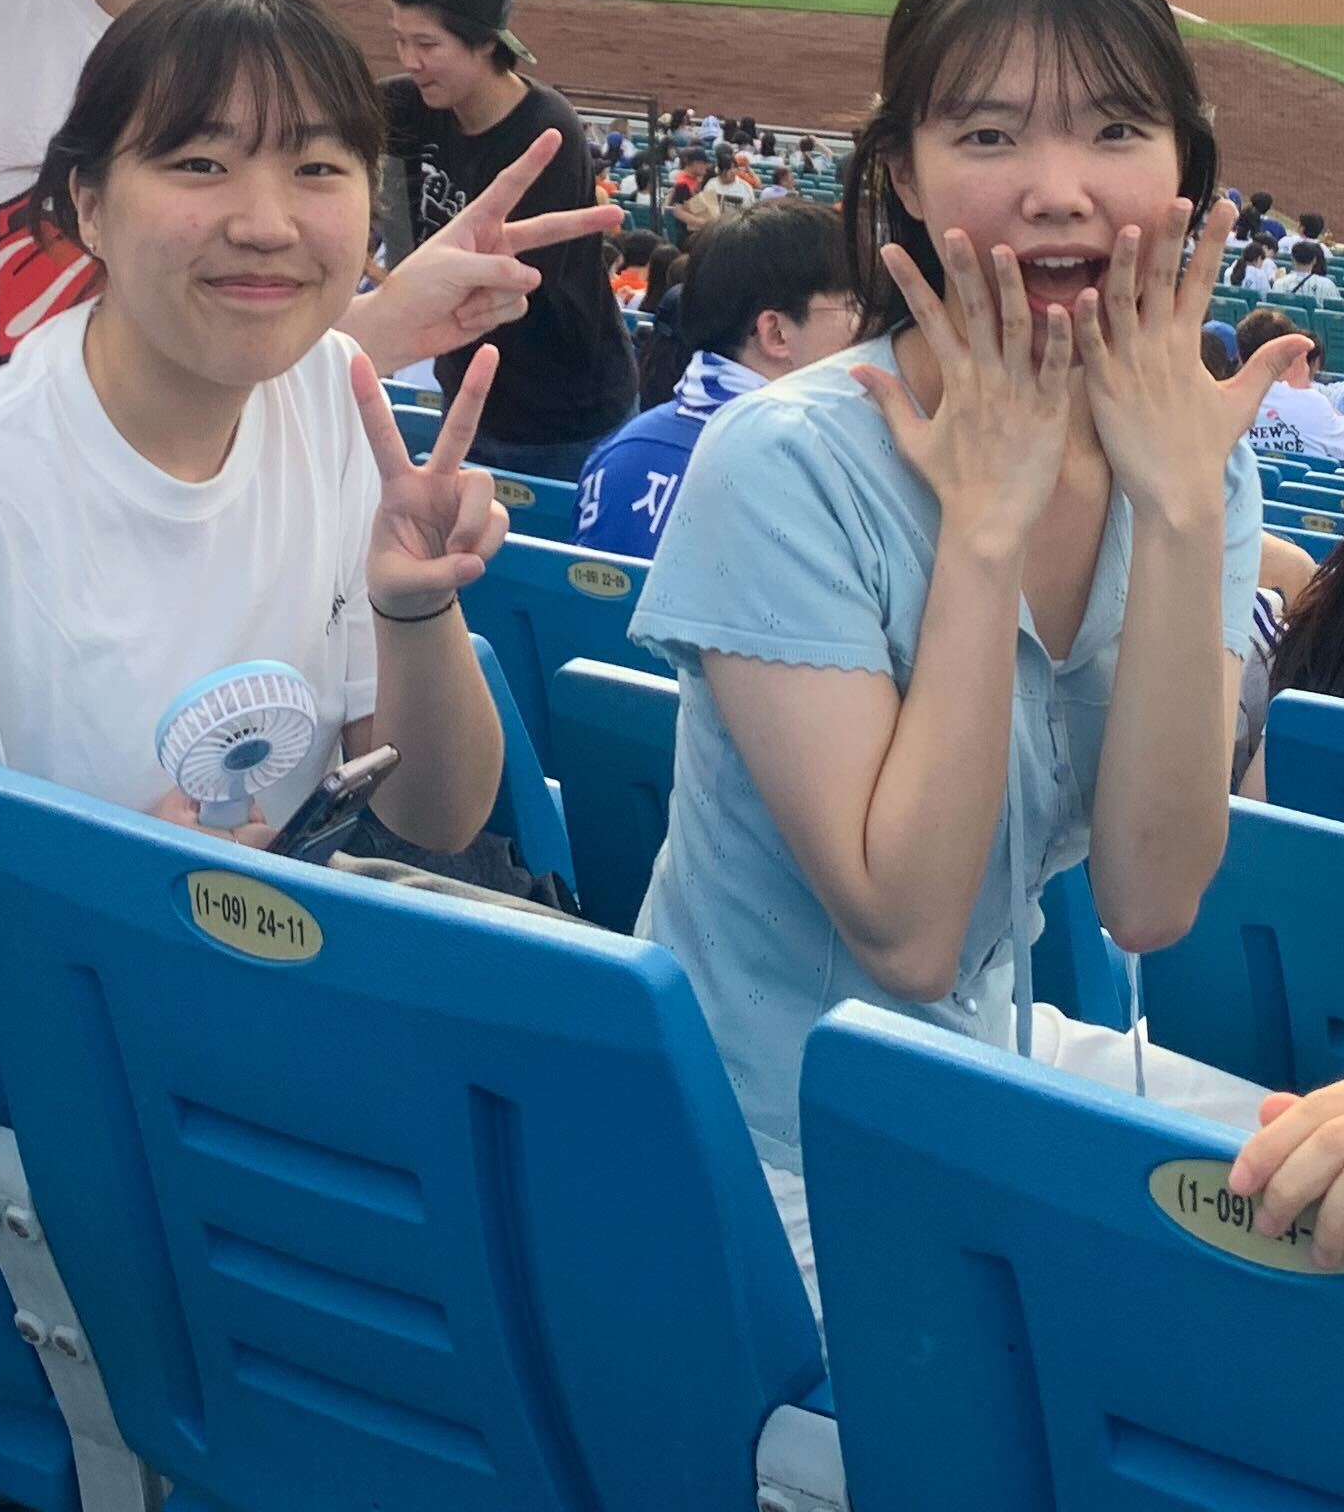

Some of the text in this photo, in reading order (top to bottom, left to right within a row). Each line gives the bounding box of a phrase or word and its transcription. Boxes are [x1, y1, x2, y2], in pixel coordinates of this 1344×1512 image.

[1249, 425, 1282, 439] NEW
[196, 882, 305, 947] (1-09) 24-11
[1178, 1173, 1254, 1233] (1-09)
